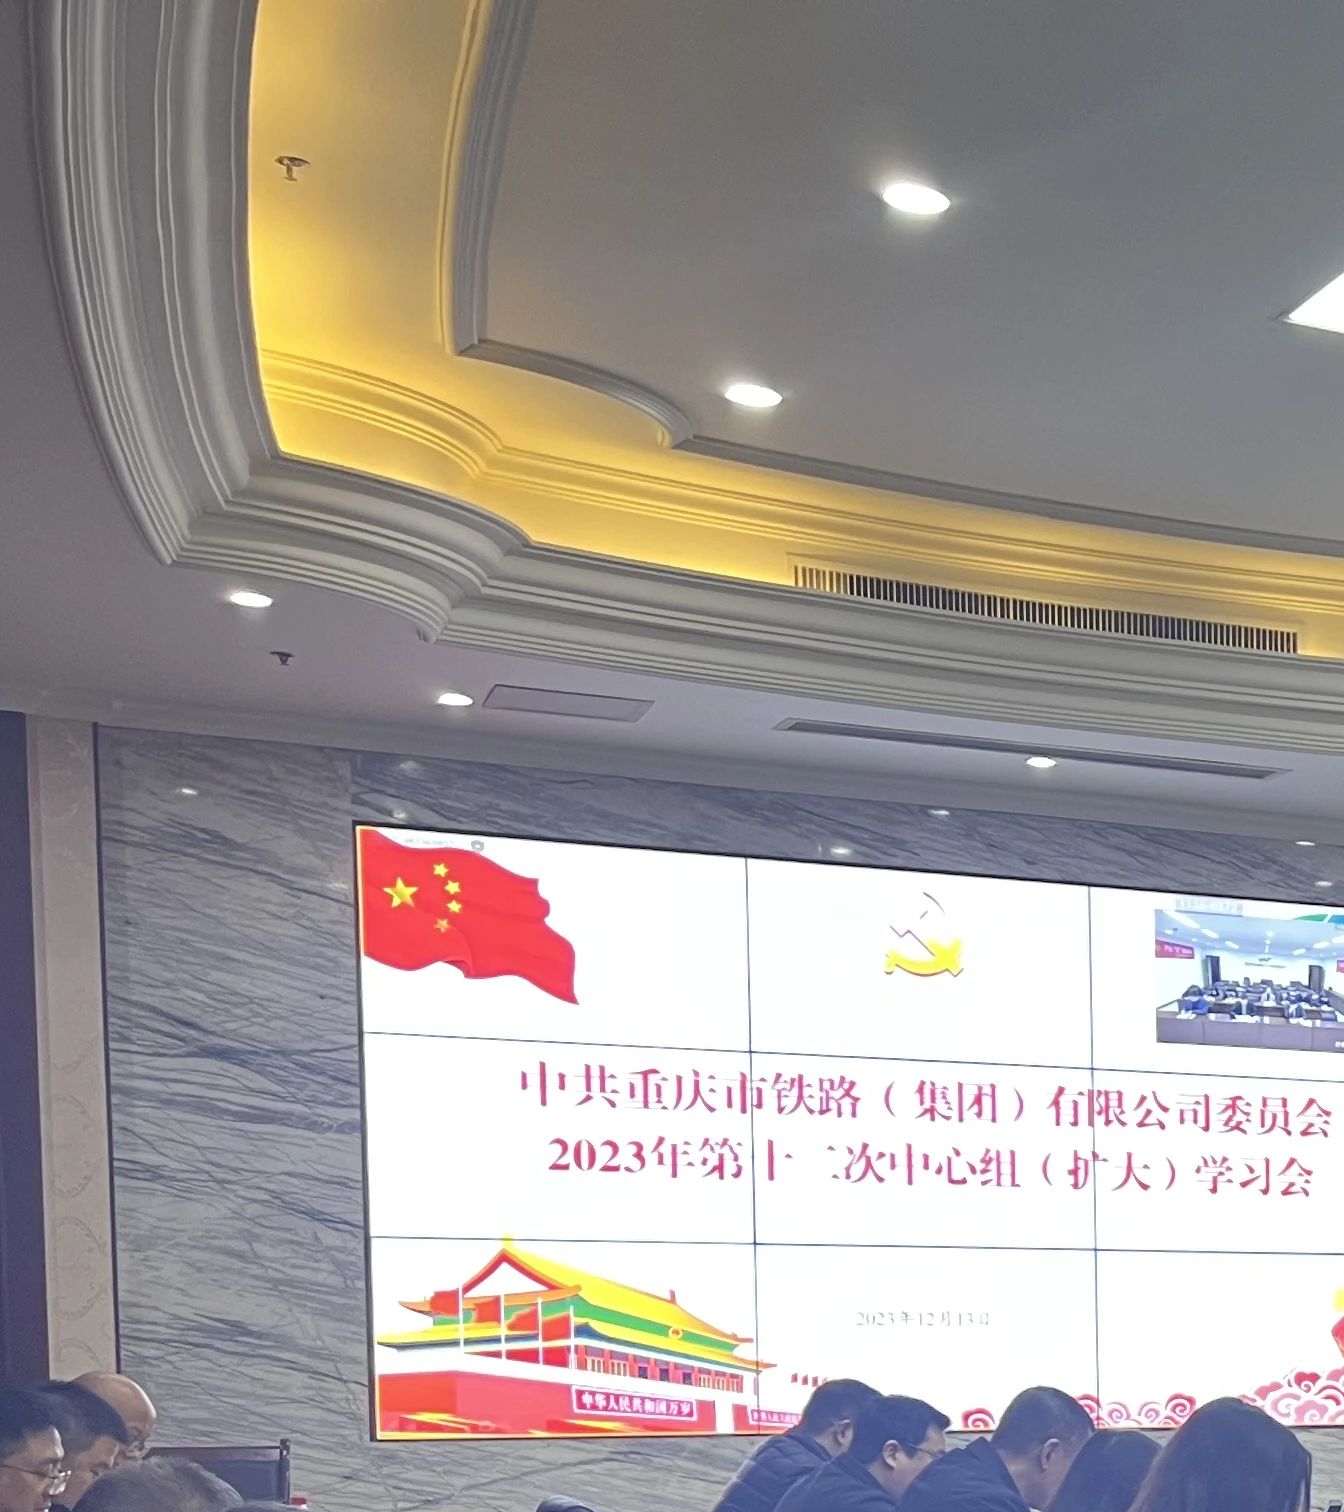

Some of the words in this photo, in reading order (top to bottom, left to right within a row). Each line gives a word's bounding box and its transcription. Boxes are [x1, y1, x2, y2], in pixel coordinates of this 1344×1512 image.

[520, 1061, 1333, 1138] 中共重庆市铁路（集团）有限公司委员会
[548, 1136, 1314, 1198] 2023年第十二次中心组（扩大）学习会
[581, 1391, 691, 1416] 中华人民共和国万岁
